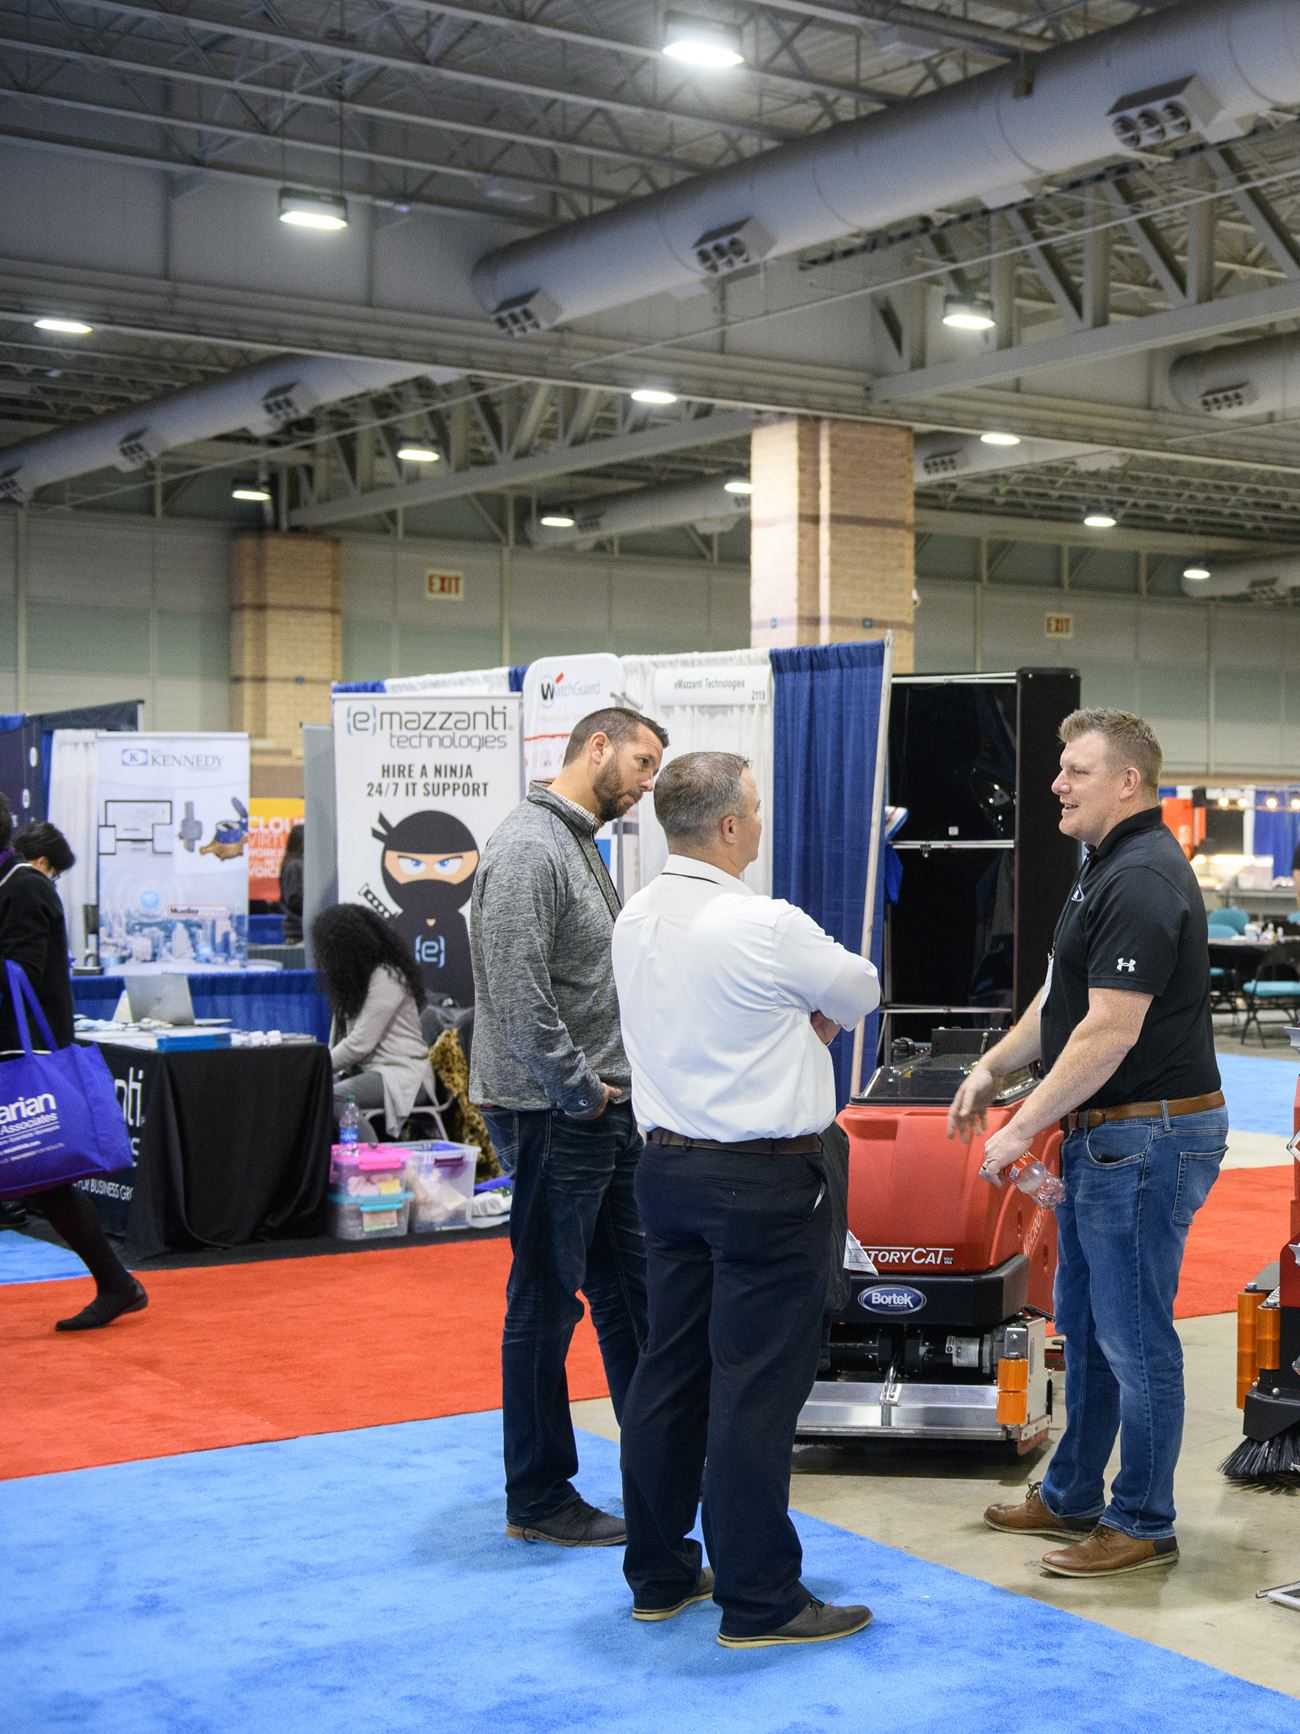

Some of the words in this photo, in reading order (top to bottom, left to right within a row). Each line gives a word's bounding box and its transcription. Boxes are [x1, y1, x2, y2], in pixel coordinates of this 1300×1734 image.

[705, 678, 746, 691] Technologies
[390, 731, 508, 752] technologies
[151, 753, 225, 767] KENNEDY
[381, 764, 415, 778] HIRE
[420, 764, 428, 778] A
[434, 764, 473, 778] NINJA
[367, 782, 399, 797] 24/7
[405, 782, 417, 797] IT
[423, 782, 489, 797] SUPPORT
[0, 1092, 58, 1125] arian
[1, 1112, 58, 1136] Associates
[90, 1178, 120, 1199] BUSINESS
[871, 1292, 914, 1308] Bortek
